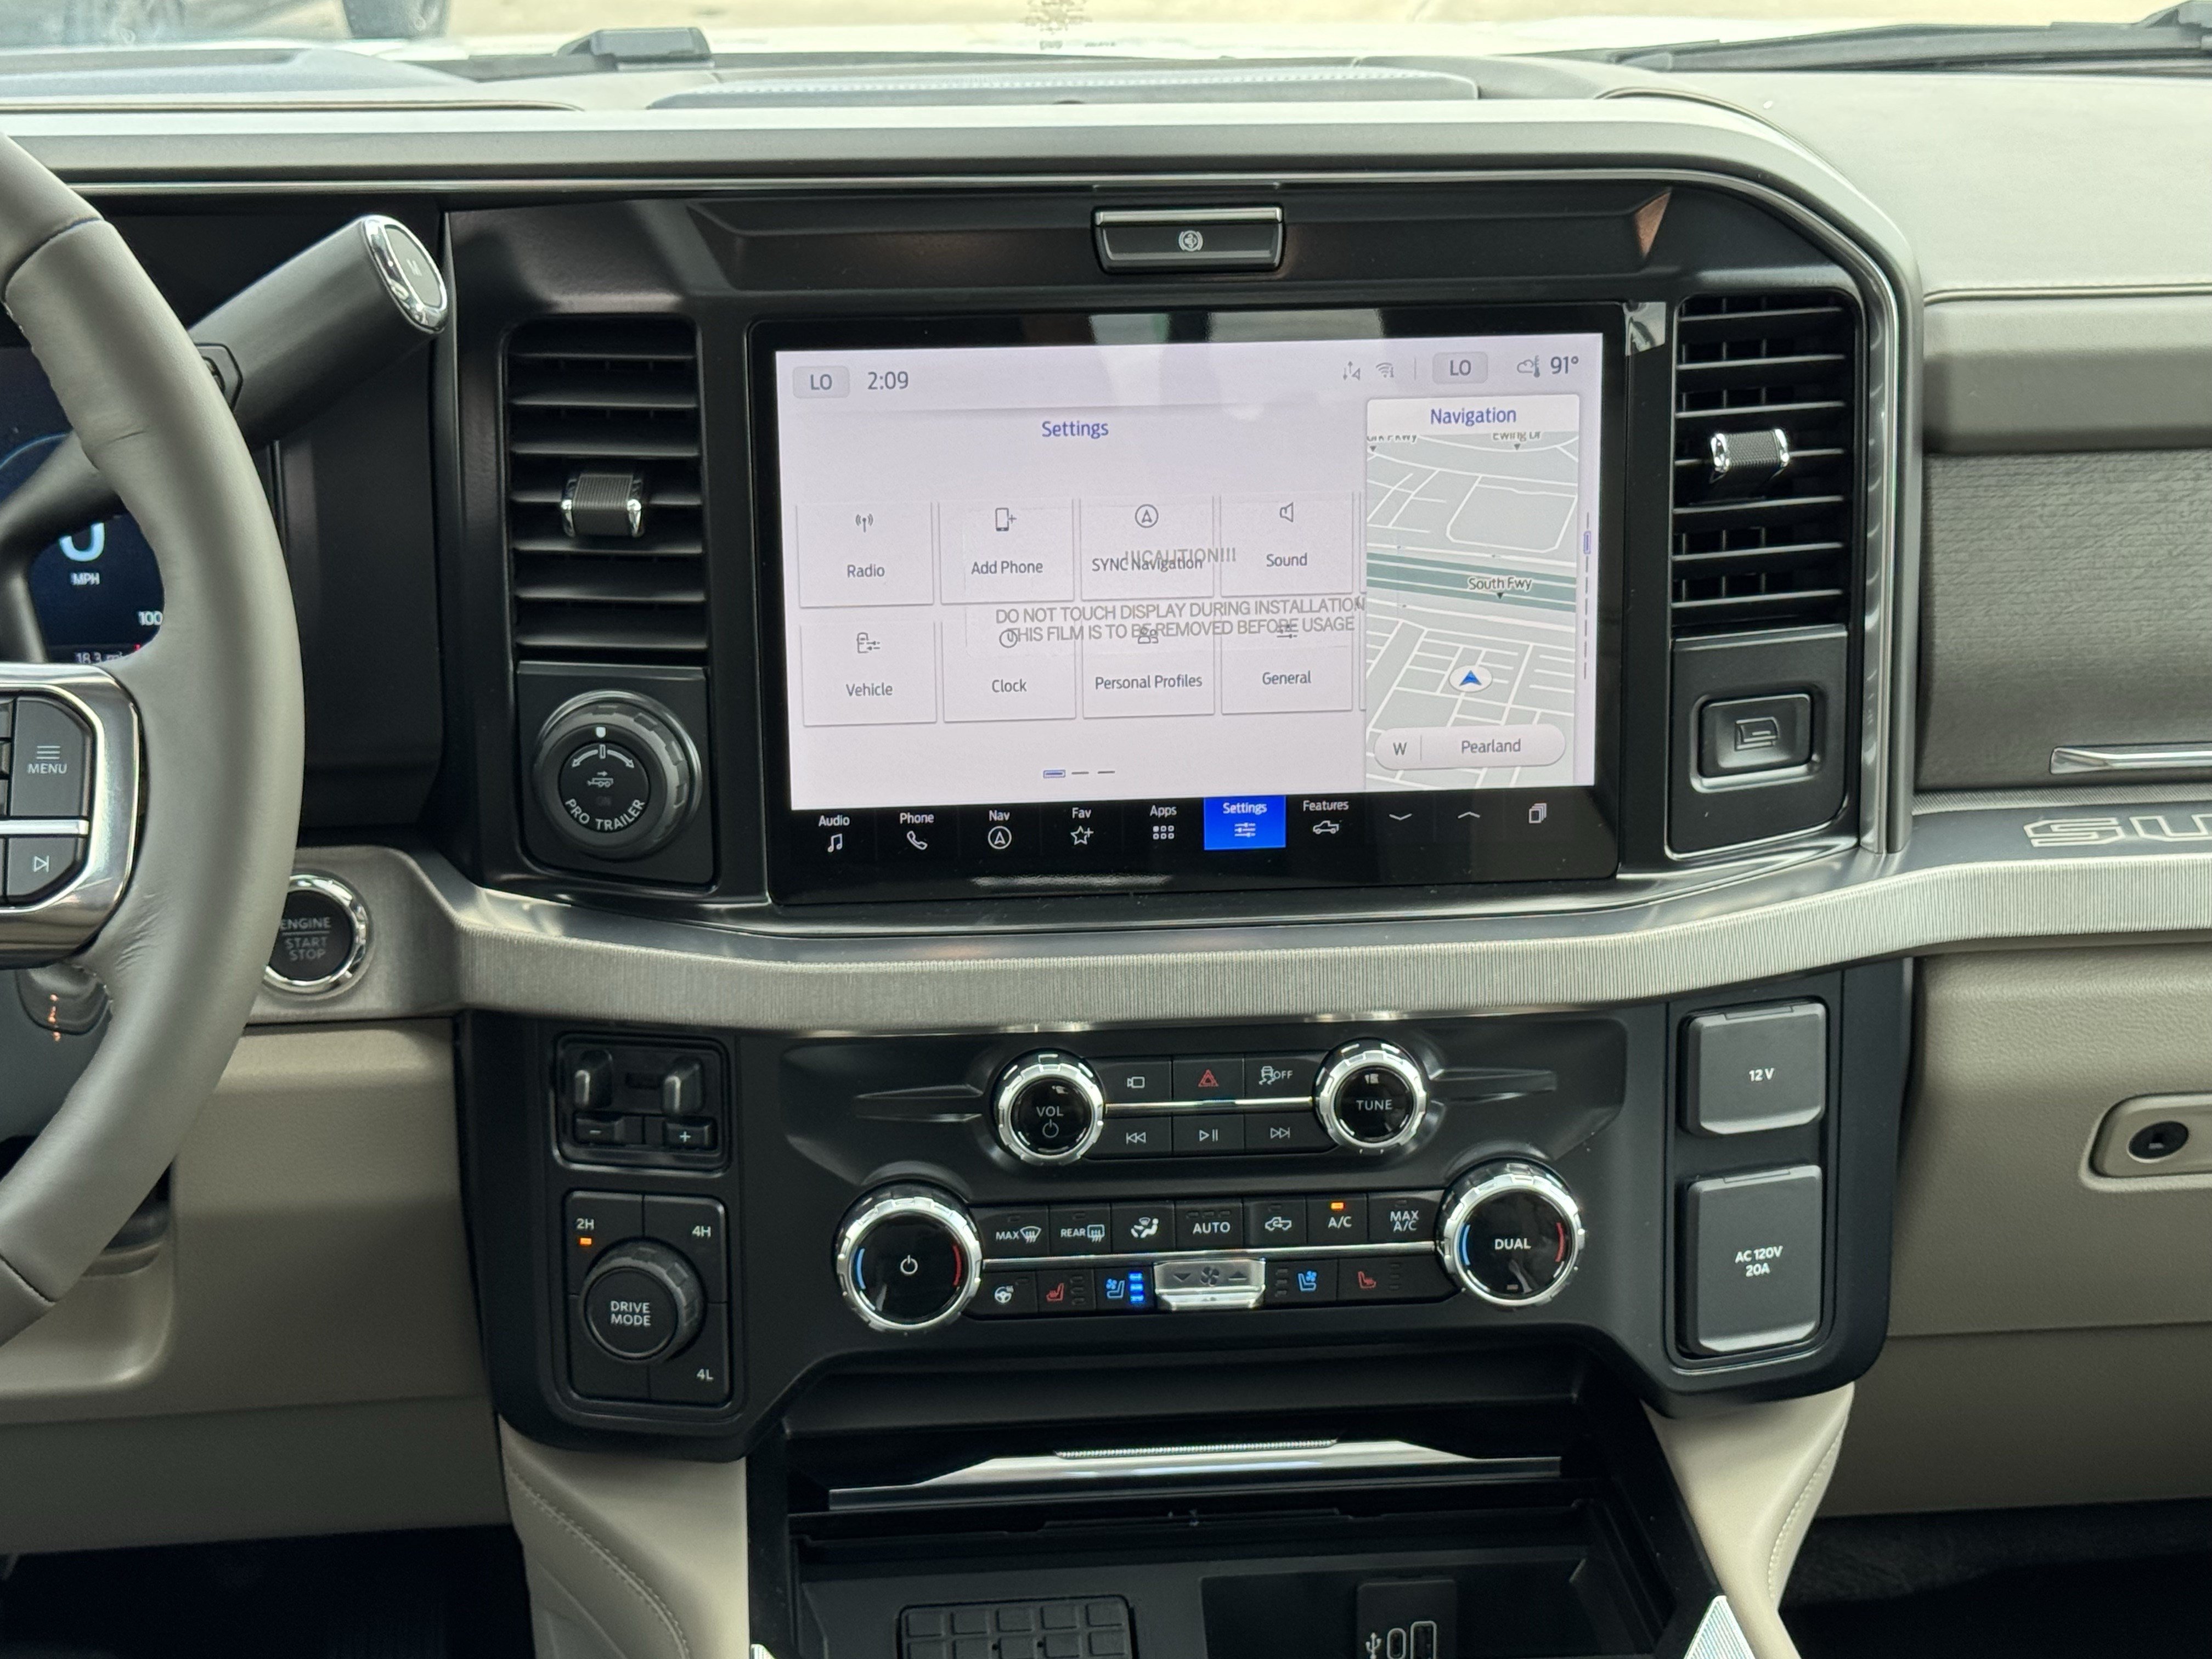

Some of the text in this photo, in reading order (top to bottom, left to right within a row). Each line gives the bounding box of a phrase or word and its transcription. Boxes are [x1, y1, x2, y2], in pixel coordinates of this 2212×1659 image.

[1450, 360, 1471, 376] LO
[1550, 356, 1579, 374] 91°
[810, 374, 832, 391] LO
[867, 371, 909, 390] 2:09
[1431, 407, 1516, 427] Navigation
[1042, 421, 1109, 438] Settings
[1092, 556, 1203, 573] SYNC Navigation
[1266, 553, 1307, 567] Sound
[847, 563, 885, 578] Radio
[972, 560, 1043, 574] Add Phone
[71, 572, 100, 585] MPH
[1469, 577, 1532, 590] South Fwy
[996, 596, 1365, 624] DO NOT TOUCH DISPLAY DURING INSTALLATION
[138, 611, 163, 626] 100
[1007, 616, 1355, 642] THIS FILM IS TO BE REMOVED BEFORE USAGE
[75, 652, 102, 664] 183
[1095, 673, 1203, 690] Personal Profiles
[1262, 670, 1312, 685] General
[846, 682, 893, 697] Vehicle
[992, 679, 1027, 693] Clock
[1393, 742, 1407, 756] W
[1461, 738, 1522, 754] Pearland
[27, 763, 67, 775] MENU
[1150, 805, 1177, 817] Apps
[1223, 801, 1268, 815] Settings
[1302, 799, 1350, 812] Features
[565, 798, 645, 831] PRO TRAILER
[900, 812, 934, 825] Phone
[989, 810, 1011, 822] Nav
[1072, 807, 1092, 819] Fav
[819, 815, 850, 827] Audio
[280, 917, 332, 930] ENGINE
[284, 936, 329, 949] START
[289, 949, 326, 961] STOP
[1273, 1070, 1294, 1080] OFF
[1748, 1068, 1764, 1081] 12
[1036, 1105, 1064, 1118] VOL
[1356, 1099, 1393, 1111] TUNE
[1328, 1216, 1352, 1229] A/C
[1390, 1210, 1419, 1222] MAX
[576, 1218, 595, 1231] 2H
[1193, 1221, 1231, 1234] AUTO
[1392, 1220, 1418, 1232] A/C
[692, 1226, 712, 1238] 4H
[996, 1231, 1020, 1240] MAX
[1060, 1228, 1086, 1238] REAR
[1494, 1238, 1532, 1250] DUAL
[1735, 1245, 1783, 1263] AC 120V
[1745, 1263, 1770, 1277] 20A
[610, 1300, 651, 1314] DRIVE
[611, 1313, 651, 1327] MODE
[696, 1369, 714, 1381] 4L
